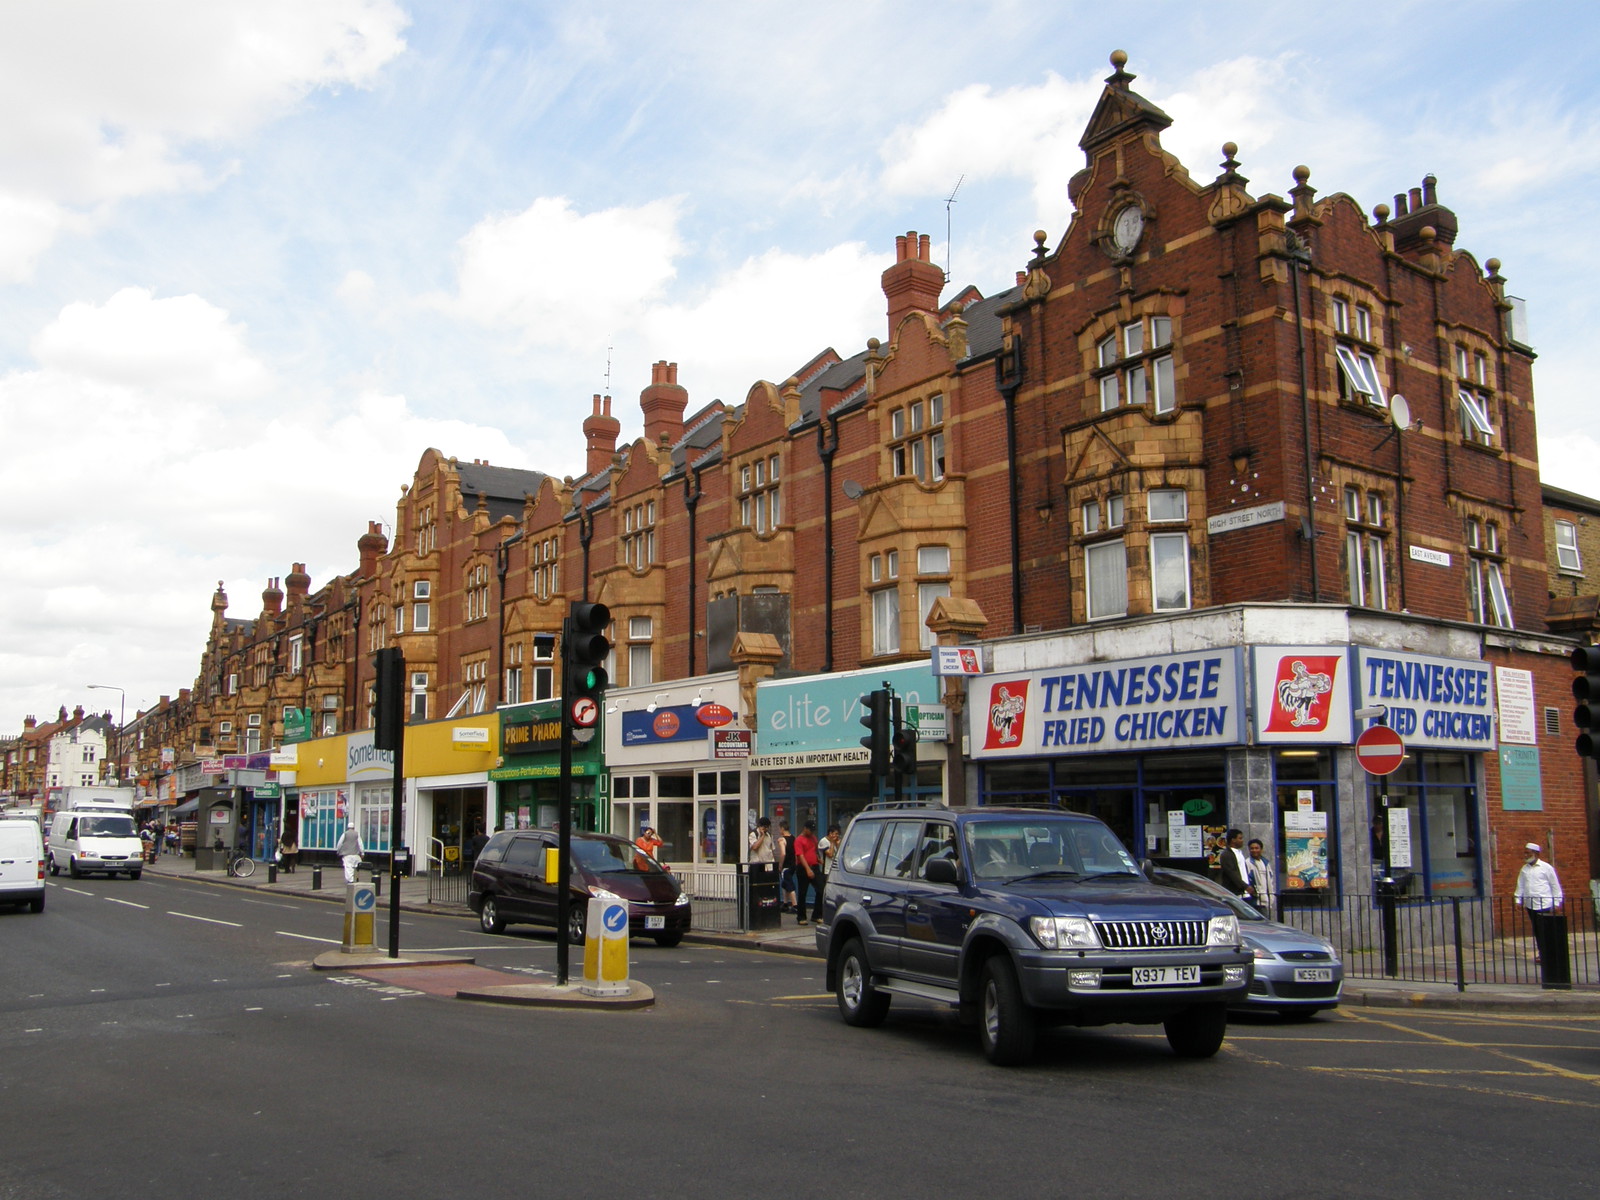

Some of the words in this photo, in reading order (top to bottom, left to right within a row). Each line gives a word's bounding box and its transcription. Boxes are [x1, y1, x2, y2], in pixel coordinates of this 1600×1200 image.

[1209, 520, 1227, 529] HIGH
[1229, 512, 1254, 525] STREET
[1256, 507, 1281, 519] NORTH
[1411, 548, 1422, 558] EAST
[1424, 551, 1442, 562] AVENUE
[1040, 658, 1221, 713] TENNESSEE
[1366, 656, 1488, 707] TENNESSEE
[771, 693, 831, 731] elite
[918, 712, 945, 721] OPTICIAN
[505, 726, 529, 744] PRIME
[532, 721, 562, 742] PHARM
[1041, 717, 1105, 747] FRIED
[1115, 706, 1228, 742] CHICKEN
[1422, 709, 1492, 740] CHICKEN
[726, 732, 740, 741] JK
[751, 758, 759, 767] AN
[760, 757, 771, 766] EYE
[772, 756, 786, 766] TEST
[788, 755, 794, 764] IS
[795, 755, 804, 764] AN
[806, 752, 841, 763] IMPORTANT
[843, 751, 869, 761] HEALTH
[1514, 750, 1536, 760] TRINITY
[1134, 968, 1166, 983] X937
[1173, 967, 1196, 981] TEV
